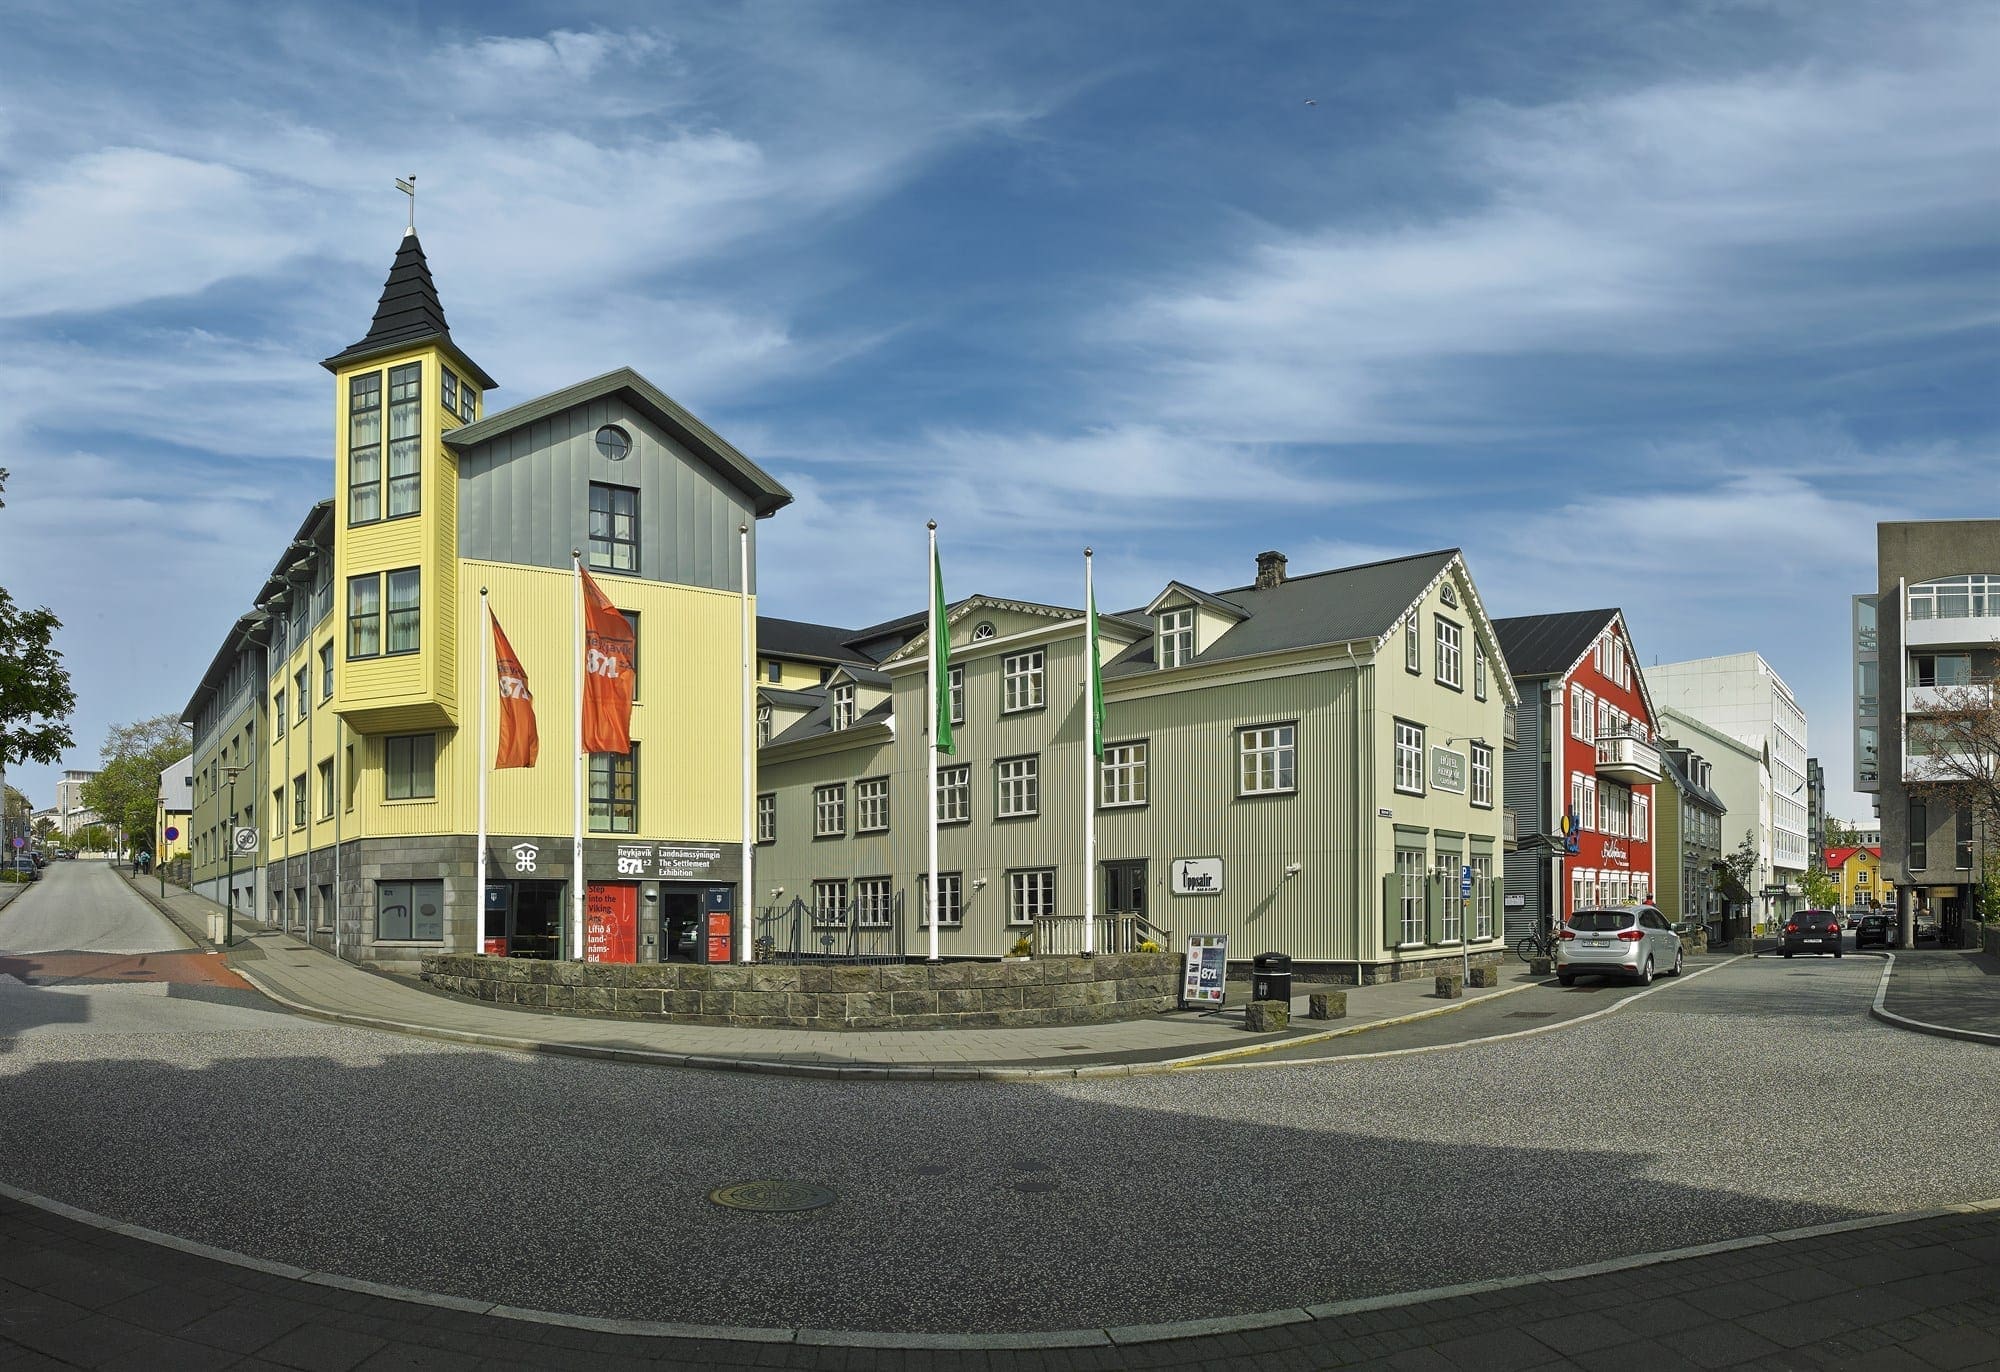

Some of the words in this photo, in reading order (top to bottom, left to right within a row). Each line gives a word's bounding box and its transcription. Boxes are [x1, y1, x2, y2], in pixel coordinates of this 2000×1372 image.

[588, 648, 619, 678] 871
[239, 834, 254, 844] 30
[659, 849, 721, 860] Landnámssýningin
[659, 859, 672, 867] The
[673, 859, 710, 868] Settlement
[659, 868, 693, 877] Exhibition
[1462, 867, 1467, 878] P
[588, 886, 605, 894] Step
[588, 904, 612, 914] Viking
[606, 924, 611, 933] á
[588, 934, 606, 943] land-
[588, 954, 600, 963] öld
[1201, 967, 1217, 980] 871
